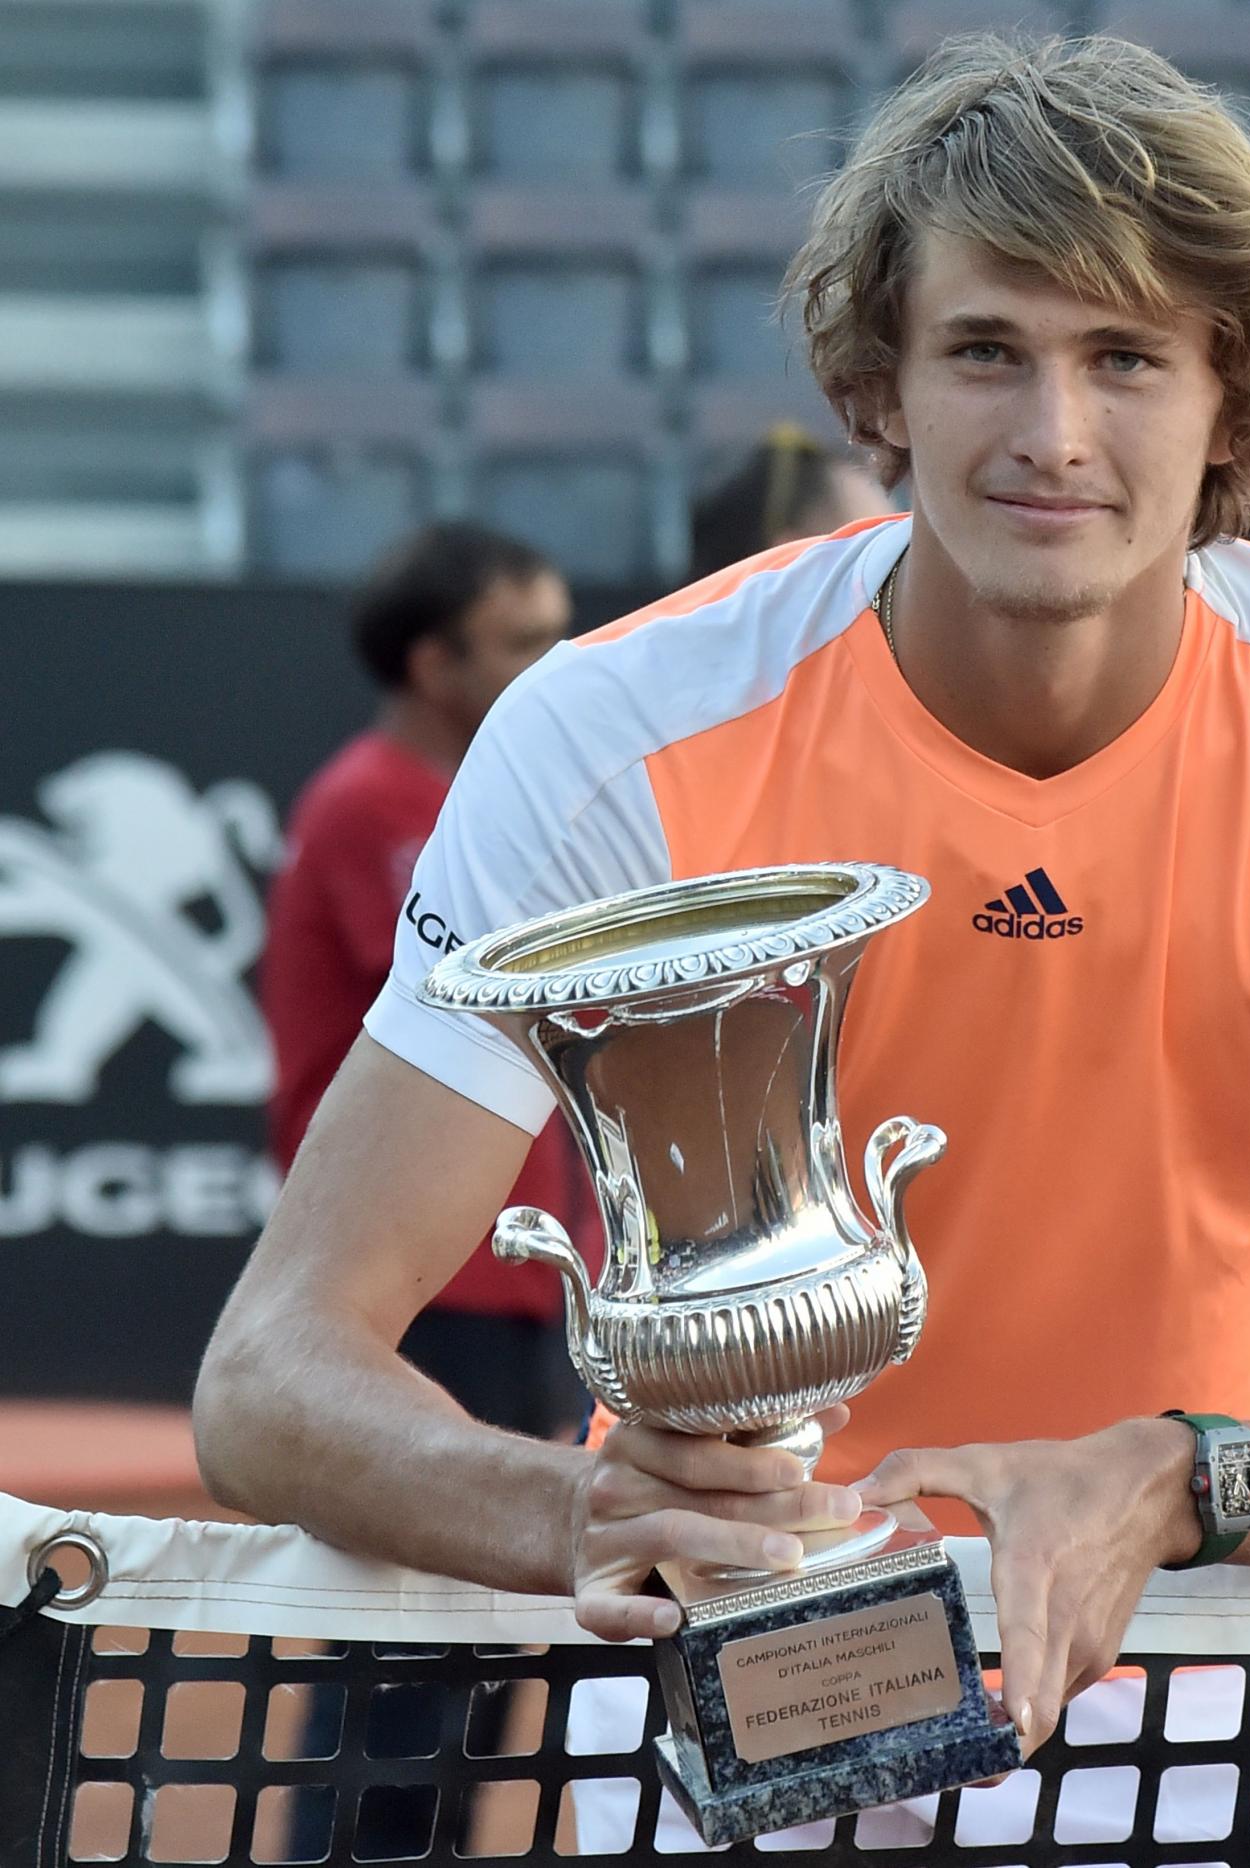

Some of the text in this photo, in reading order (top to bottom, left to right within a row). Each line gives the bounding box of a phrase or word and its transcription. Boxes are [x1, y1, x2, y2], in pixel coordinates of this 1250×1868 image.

[972, 913, 1083, 940] adidas
[736, 1611, 929, 1669] CAMPIONATI INTERNAZIONALI
[777, 1640, 896, 1679] D'ITALIA MASCHILI
[821, 1671, 862, 1688] COPPA
[745, 1687, 862, 1730] FEDERAZIONE
[868, 1666, 945, 1699] ITALIANA
[818, 1703, 881, 1731] TENNIS
